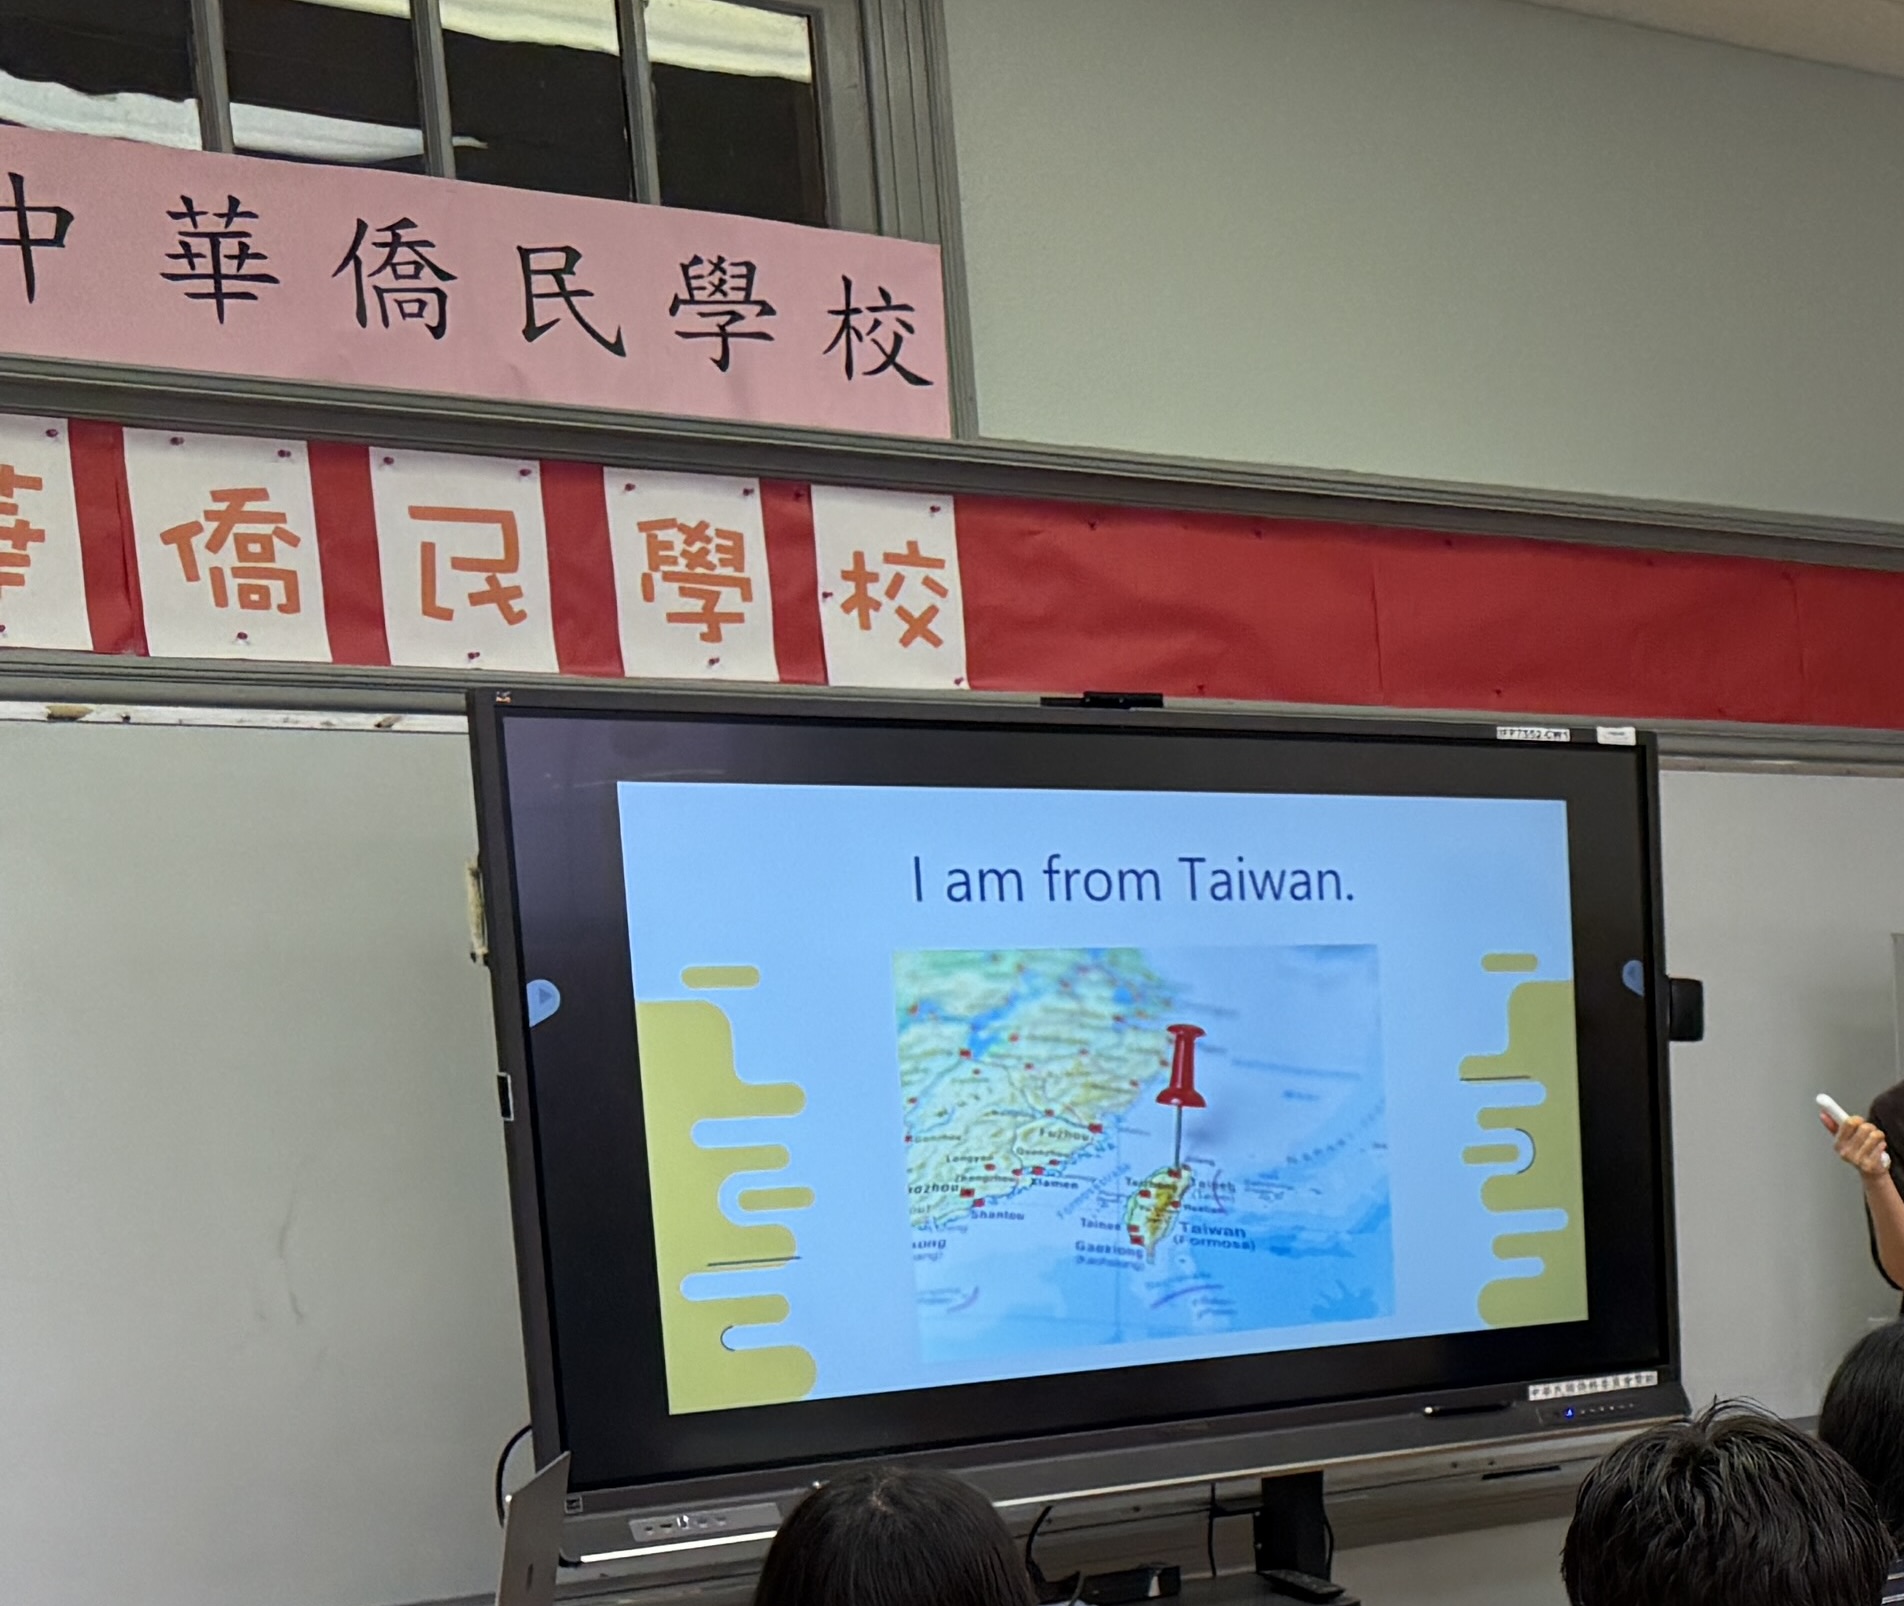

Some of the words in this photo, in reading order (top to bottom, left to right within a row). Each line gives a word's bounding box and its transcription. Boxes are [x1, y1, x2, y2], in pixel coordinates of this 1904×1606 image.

[0, 171, 934, 388] 中華僑民學校
[912, 855, 923, 903] I
[946, 867, 1024, 903] am
[1042, 854, 1161, 903] from
[1177, 855, 1355, 903] Taiwan.
[1179, 1220, 1247, 1239] Taiwan
